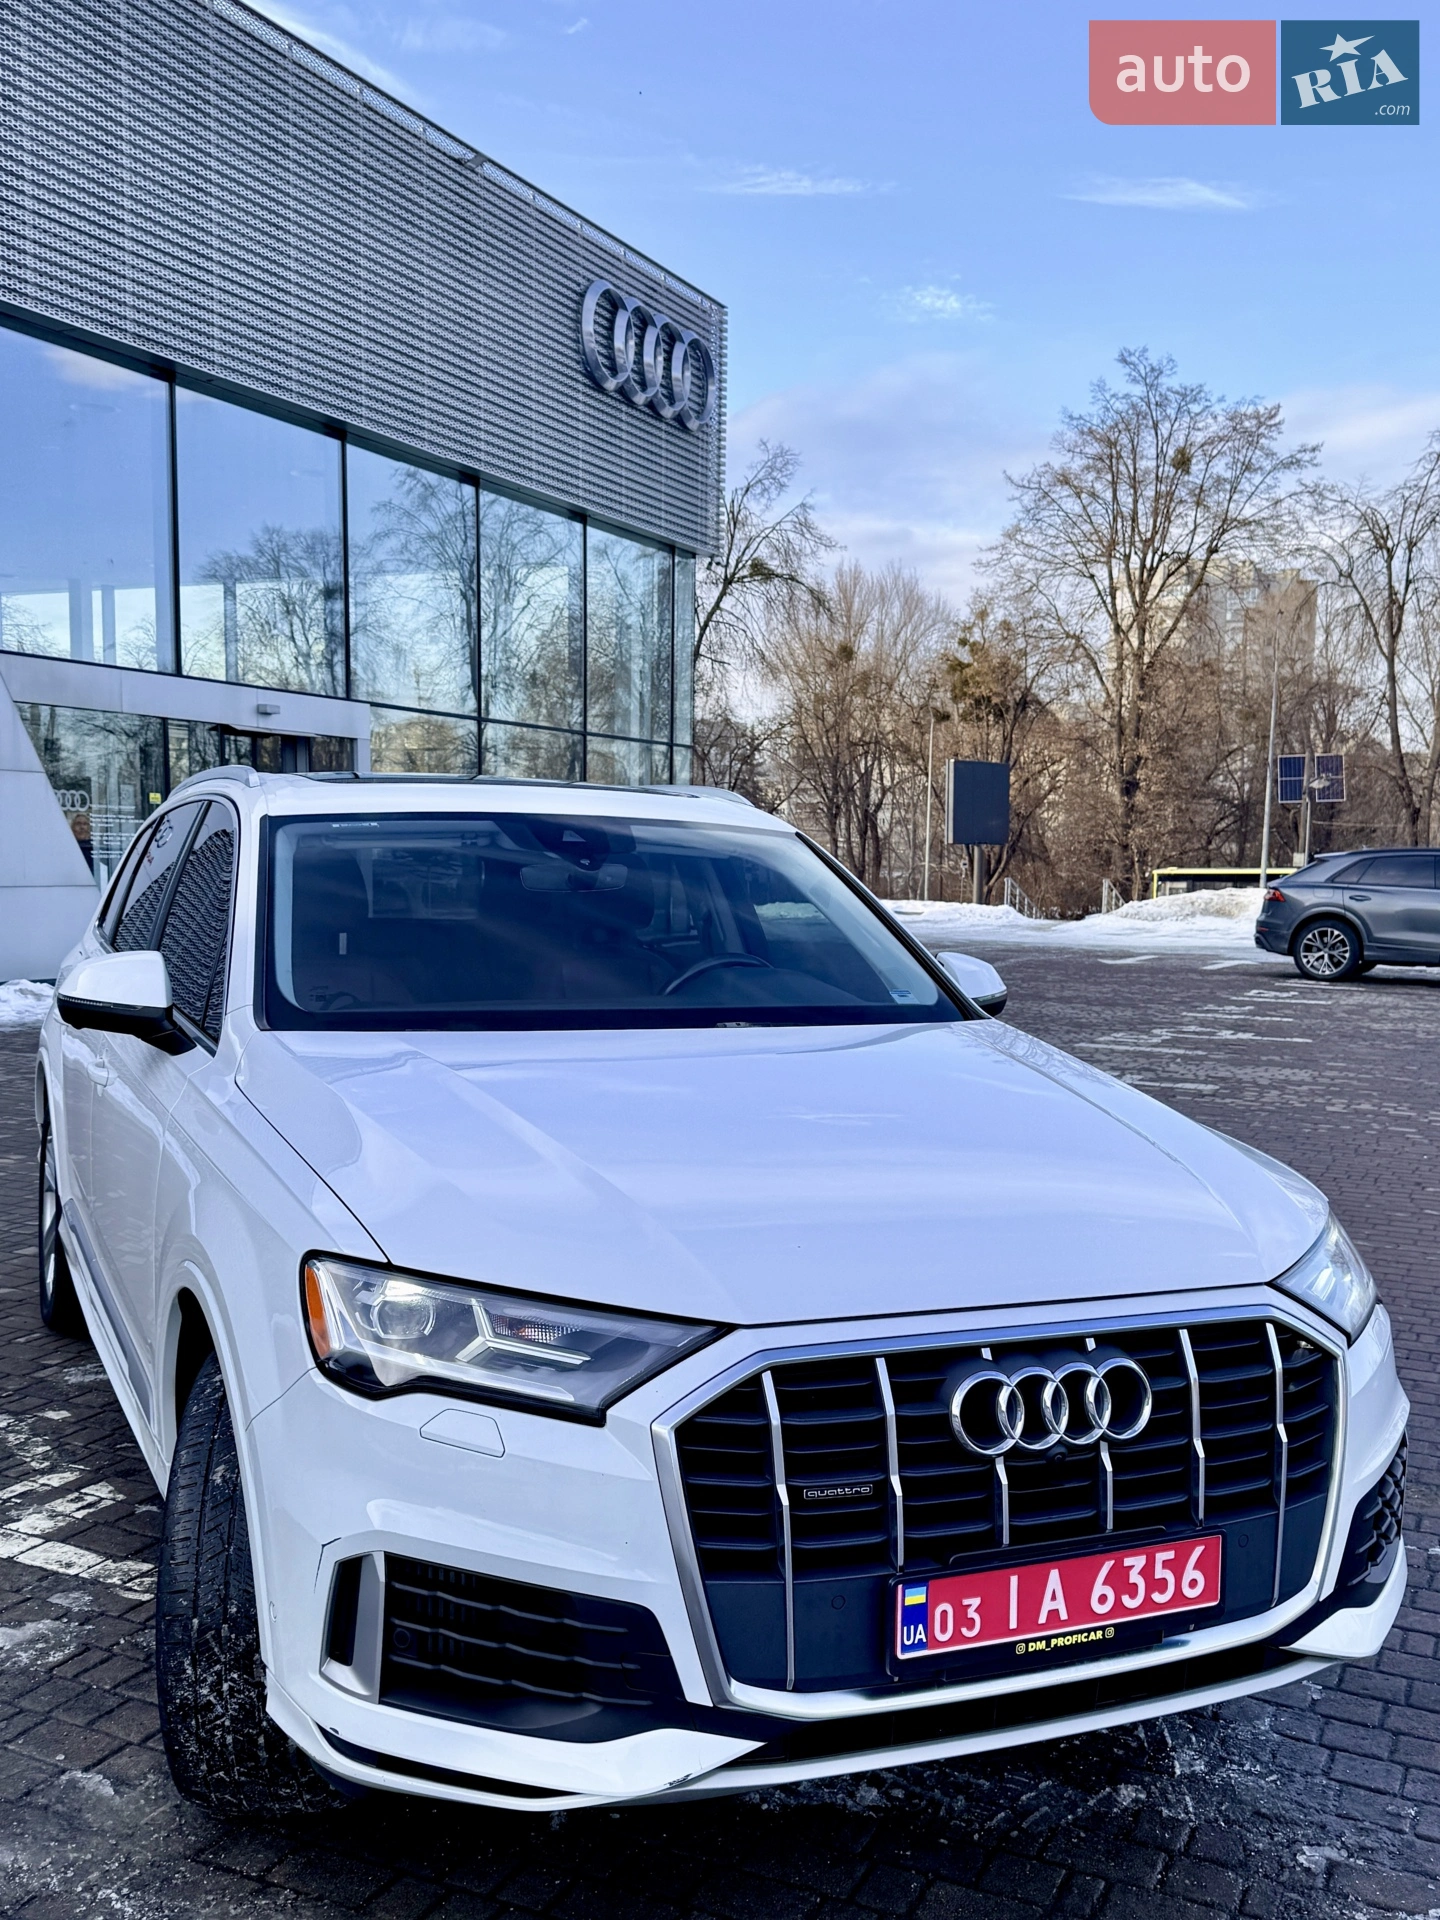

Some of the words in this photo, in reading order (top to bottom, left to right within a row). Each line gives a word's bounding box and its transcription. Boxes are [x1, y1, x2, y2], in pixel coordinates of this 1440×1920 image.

[807, 1486, 870, 1498] quattro
[933, 1597, 982, 1642] 03
[1090, 1545, 1206, 1615] 6356
[903, 1623, 927, 1646] UA
[1028, 1630, 1103, 1652] DM_PROFICAR
